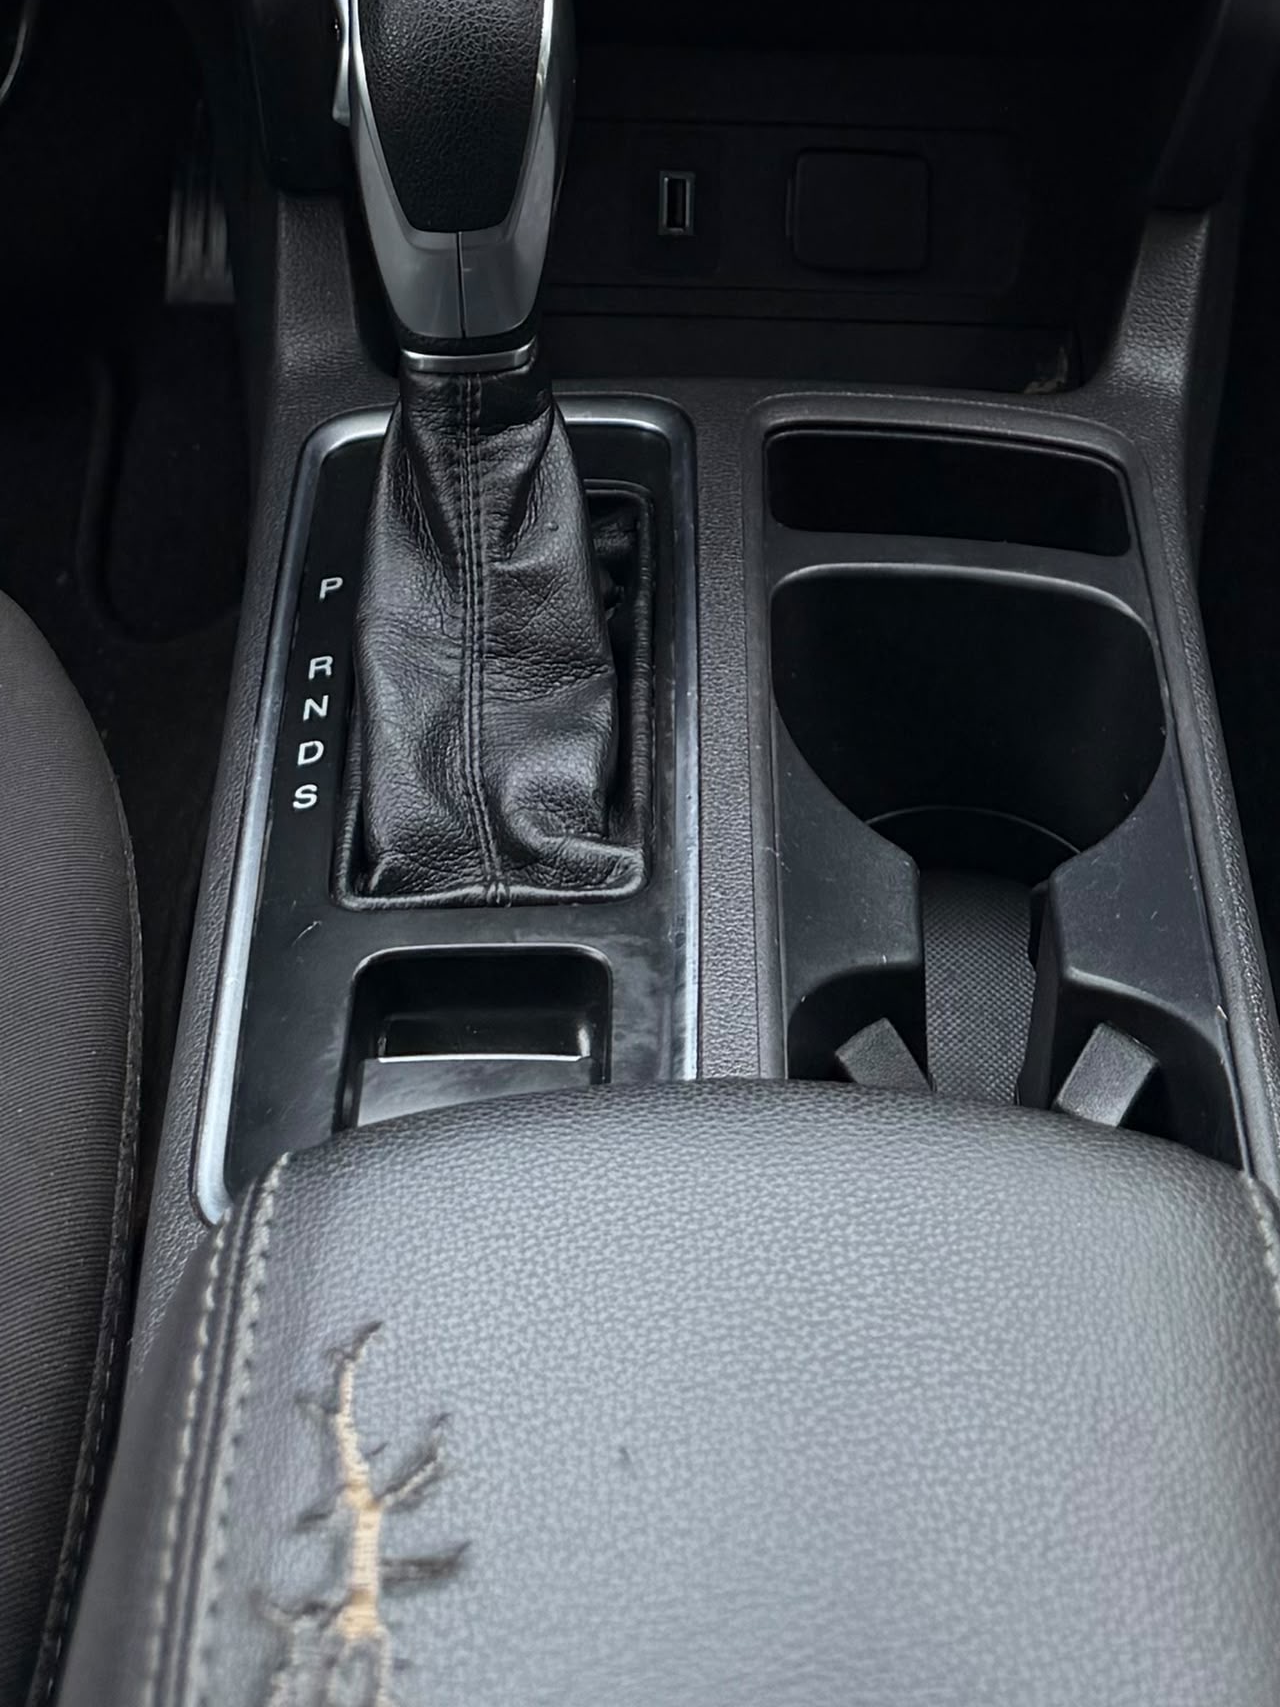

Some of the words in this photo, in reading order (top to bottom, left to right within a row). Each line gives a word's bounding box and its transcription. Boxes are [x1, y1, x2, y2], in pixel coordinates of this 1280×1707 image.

[319, 577, 343, 600] P
[308, 656, 332, 679] R
[303, 695, 329, 721] N
[297, 740, 324, 766] D
[292, 783, 318, 810] S
